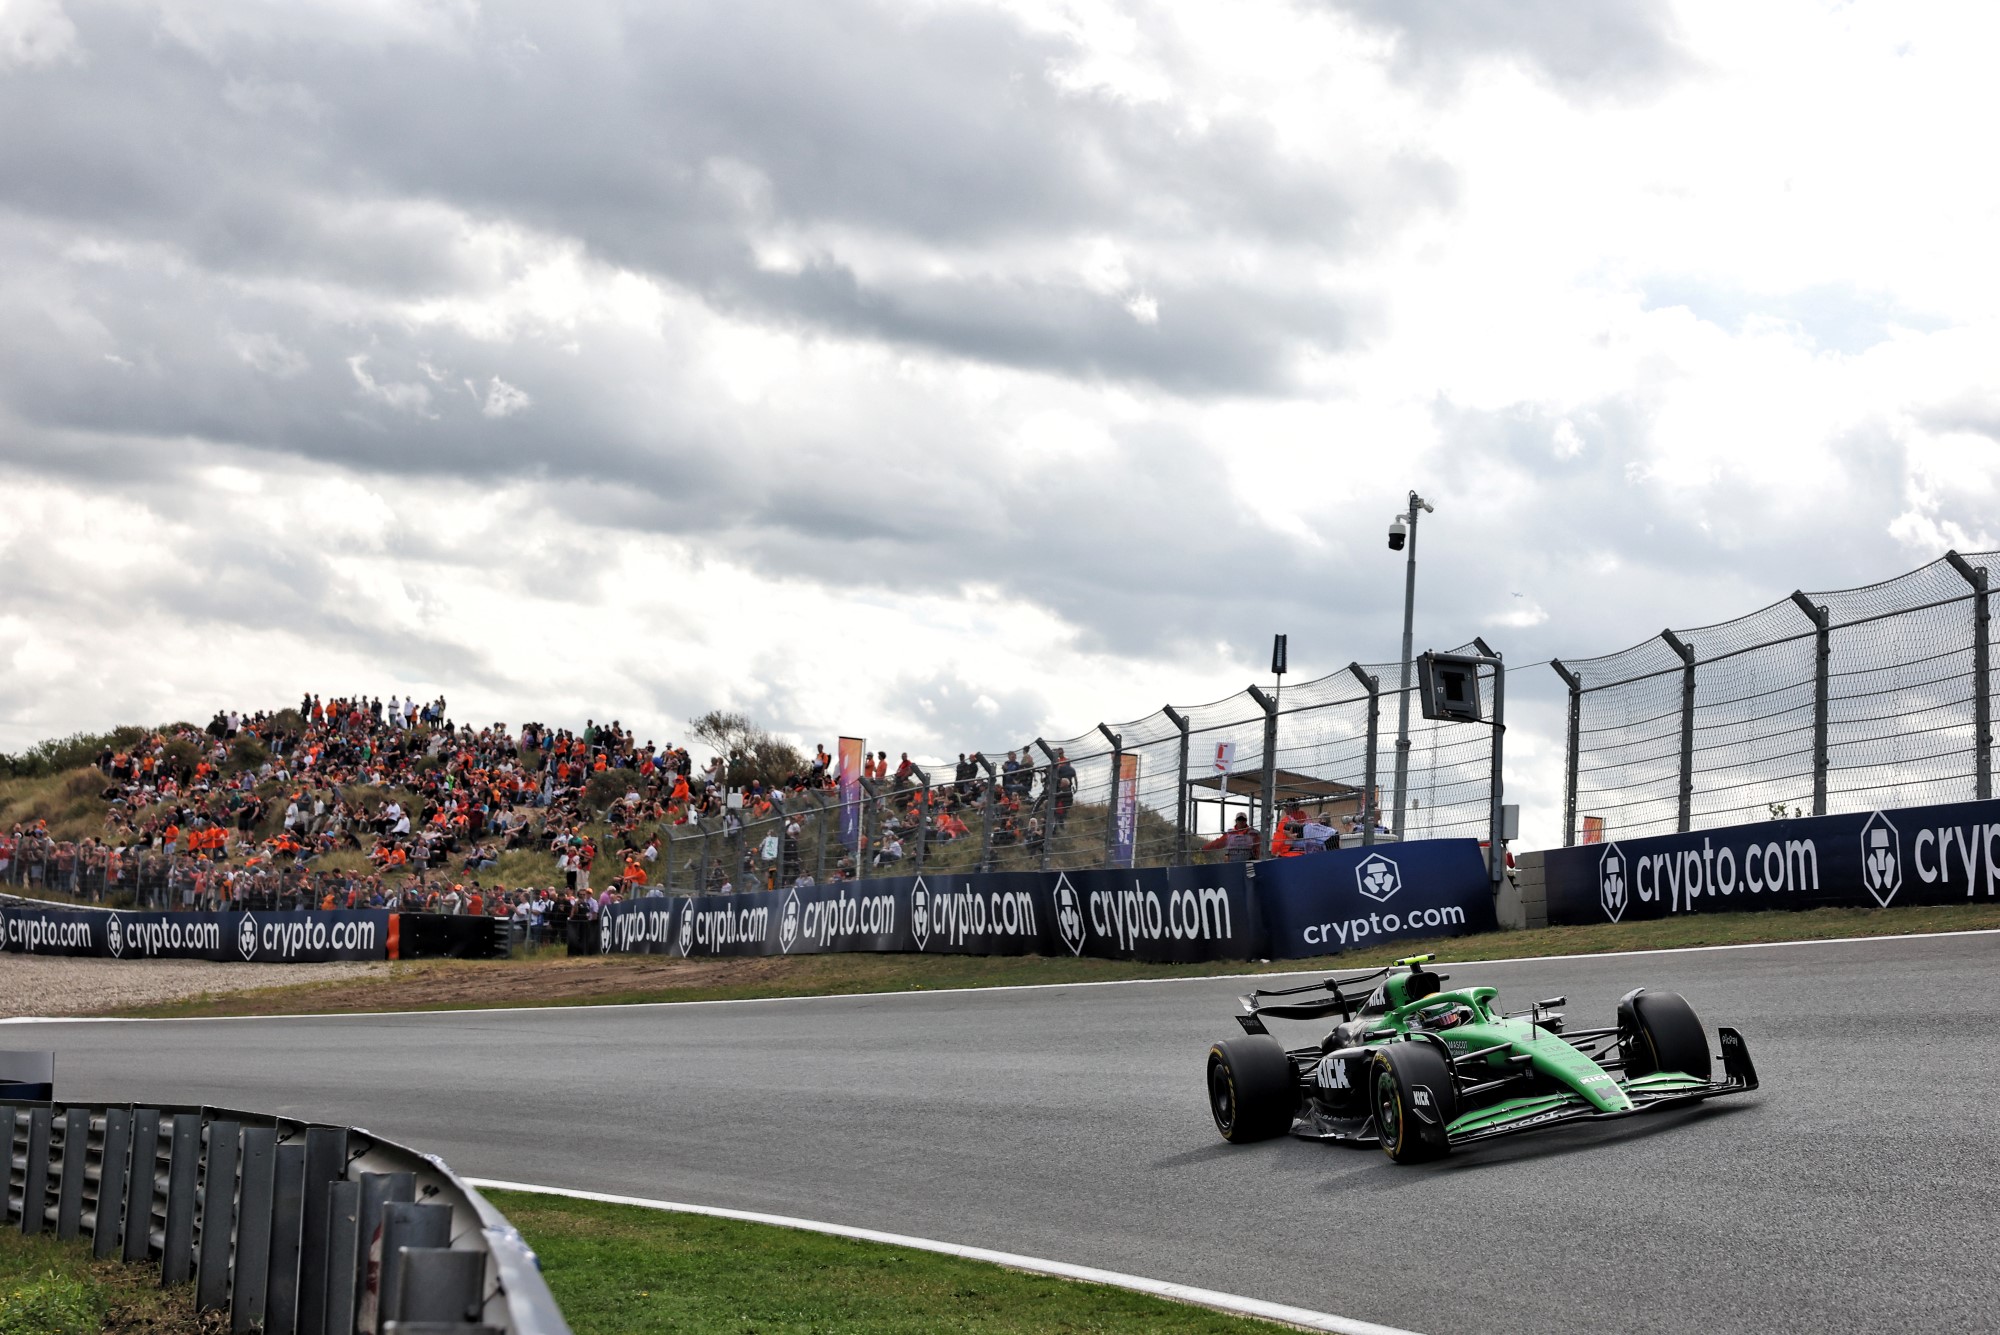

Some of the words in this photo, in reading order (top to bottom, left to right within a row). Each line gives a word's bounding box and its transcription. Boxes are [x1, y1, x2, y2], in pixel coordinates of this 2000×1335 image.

[1436, 686, 1444, 694] 17
[1636, 837, 1819, 912] crypto.com
[9, 913, 92, 950] crypto.com
[696, 902, 769, 953] crypto.com
[803, 890, 895, 946] crypto.com
[933, 883, 1038, 945] crypto.com
[1090, 879, 1232, 950] crypto.com
[1303, 905, 1466, 944] crypto.com
[127, 917, 220, 955] crypto.com
[263, 916, 375, 957] crypto.com
[1317, 1058, 1351, 1088] KICK
[1412, 1090, 1431, 1106] KICK
